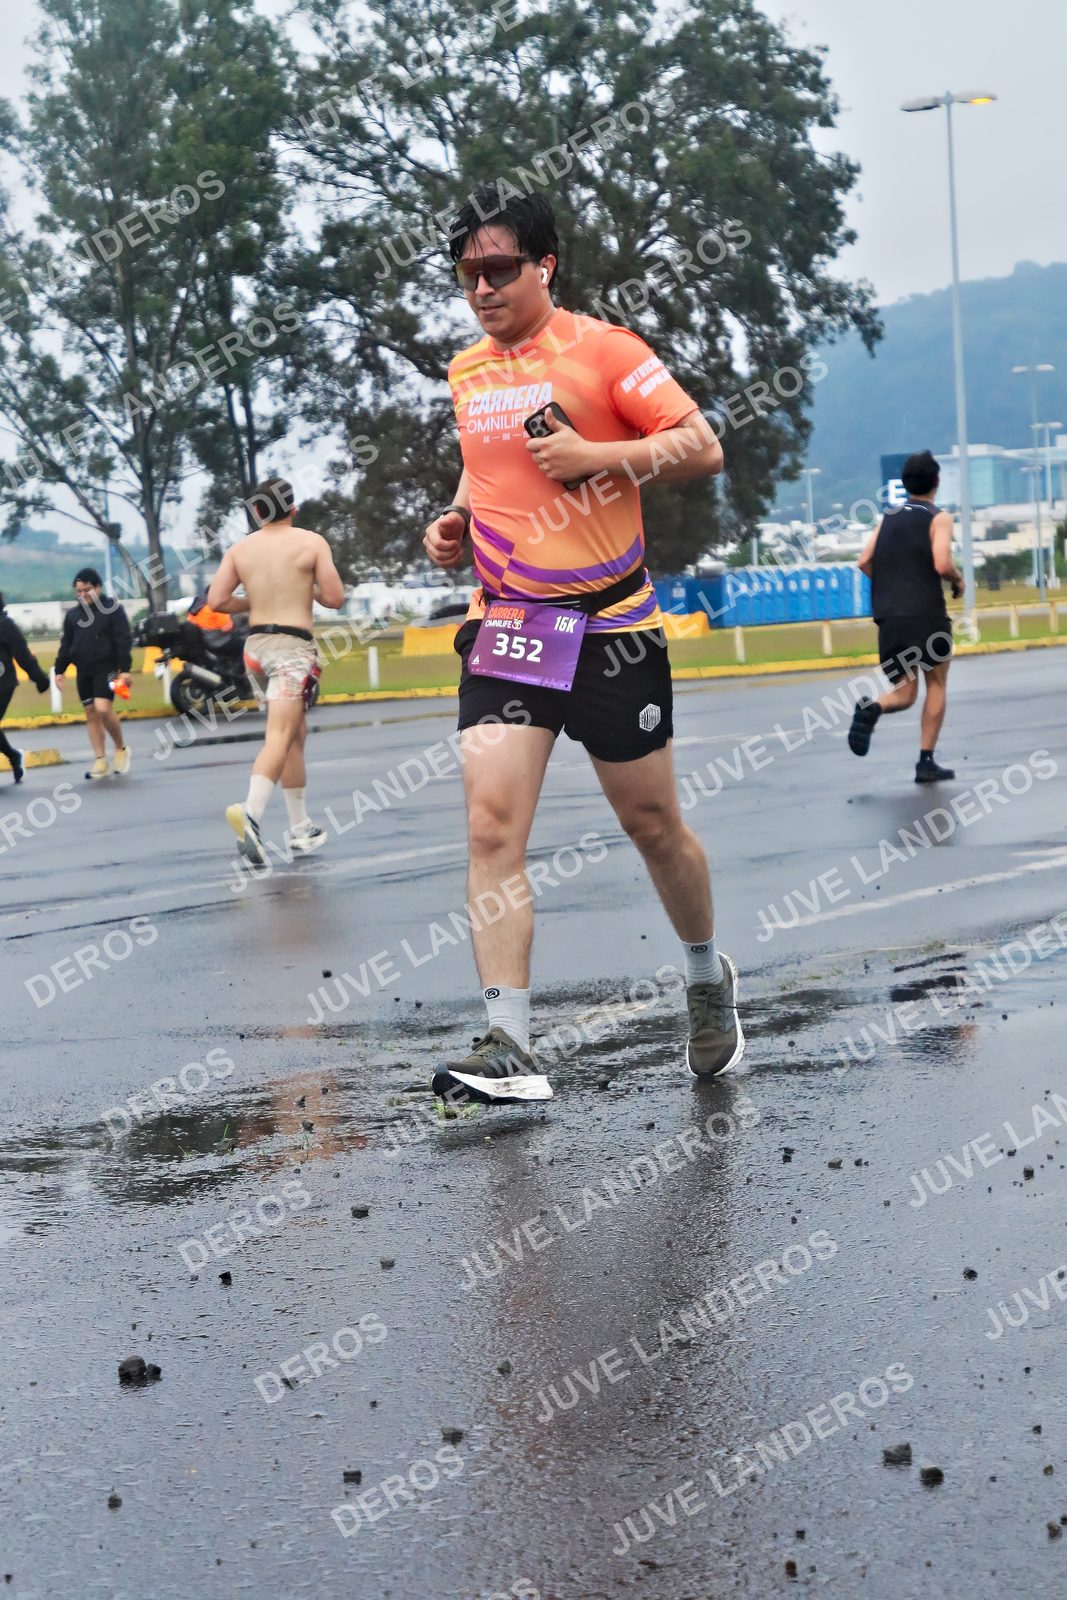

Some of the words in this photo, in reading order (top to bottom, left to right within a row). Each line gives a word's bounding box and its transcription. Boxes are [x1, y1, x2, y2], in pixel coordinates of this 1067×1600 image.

[468, 381, 553, 416] CARRERA
[488, 606, 526, 620] CARRERA
[554, 615, 578, 633] 15K
[492, 633, 544, 663] 352
